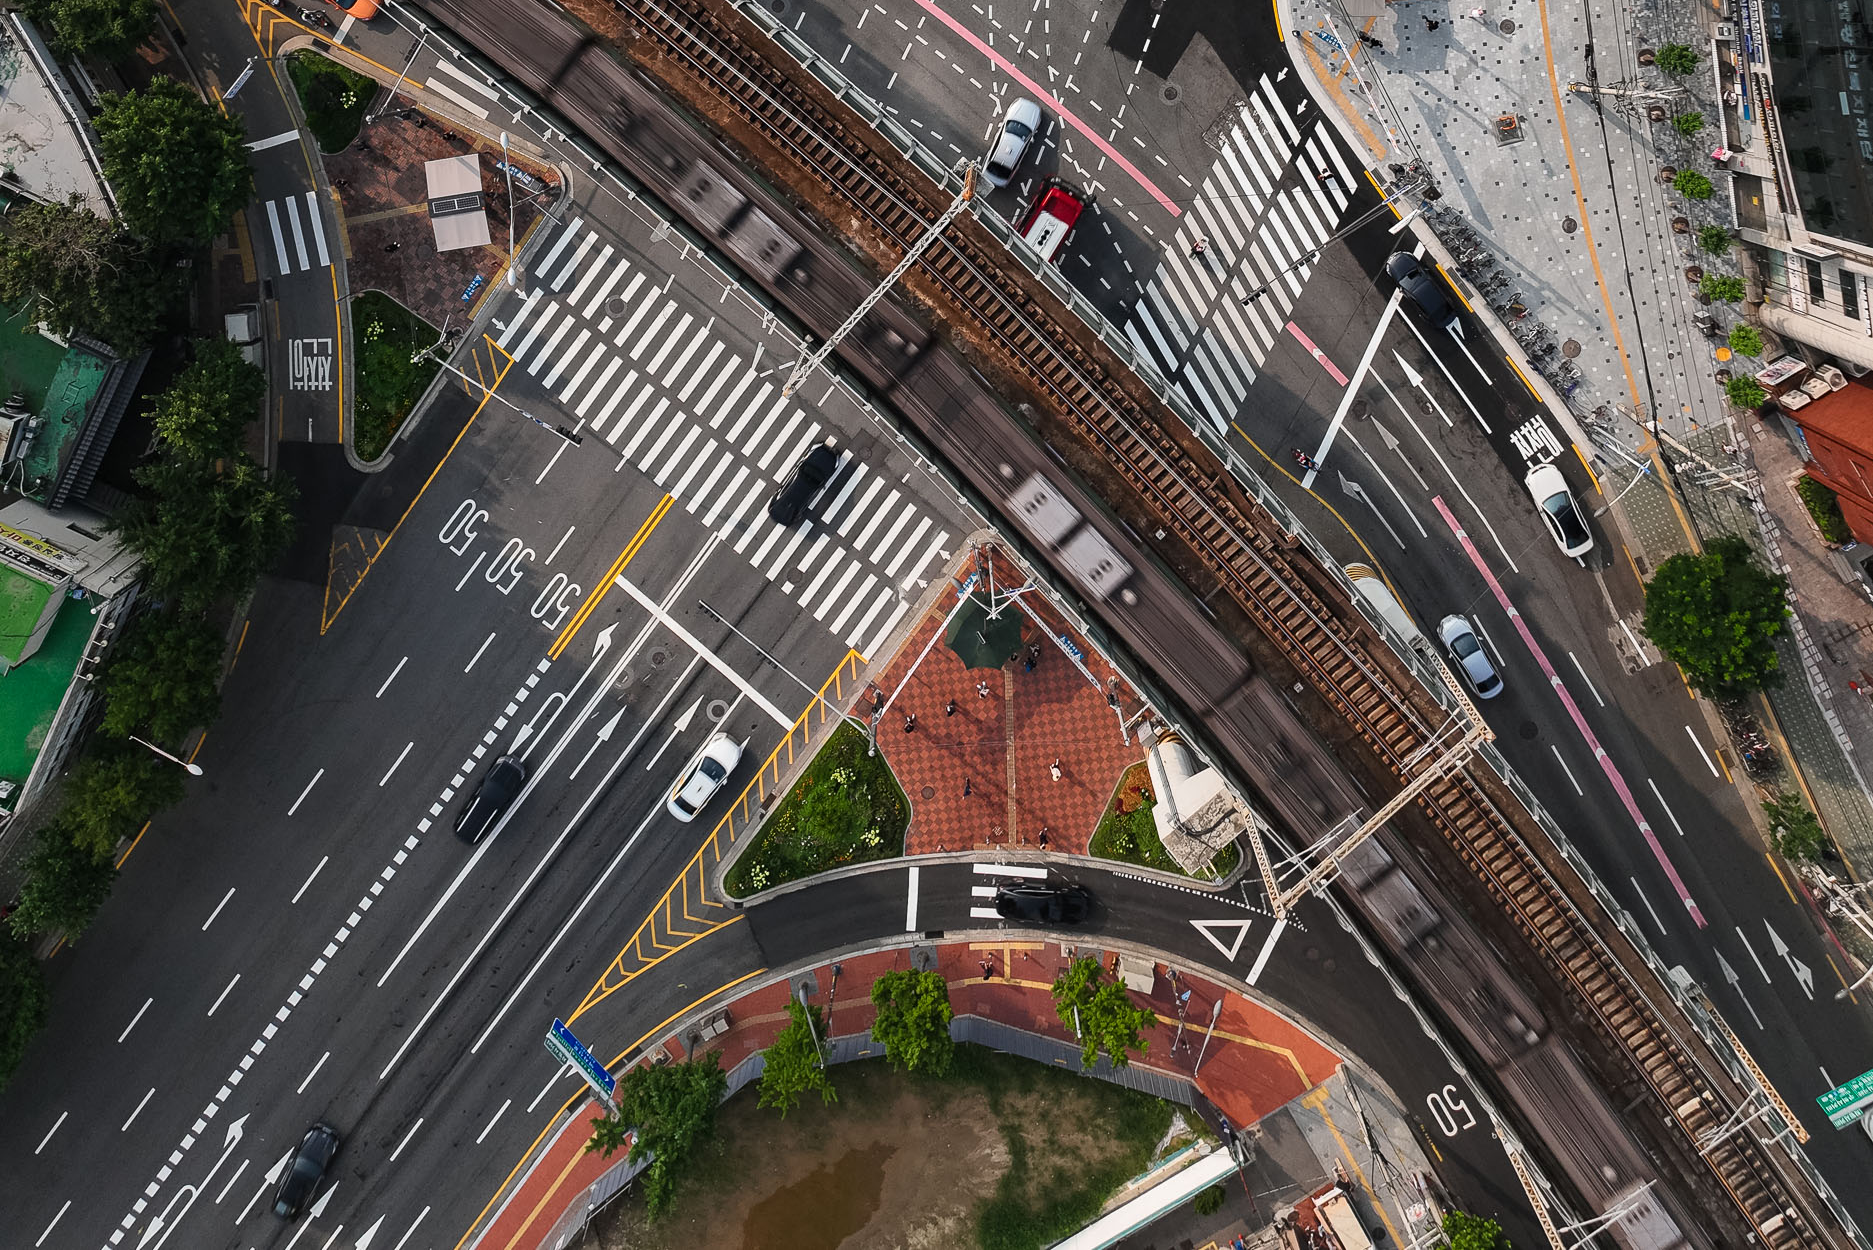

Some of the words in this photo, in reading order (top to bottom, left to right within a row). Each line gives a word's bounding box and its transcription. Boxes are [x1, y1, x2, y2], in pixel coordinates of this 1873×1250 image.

[289, 339, 332, 390] 천천히
[1510, 414, 1565, 464] 천천히
[439, 499, 489, 557] 50
[485, 538, 536, 596] 50
[531, 573, 582, 630] 50
[1427, 1085, 1477, 1137] 50
